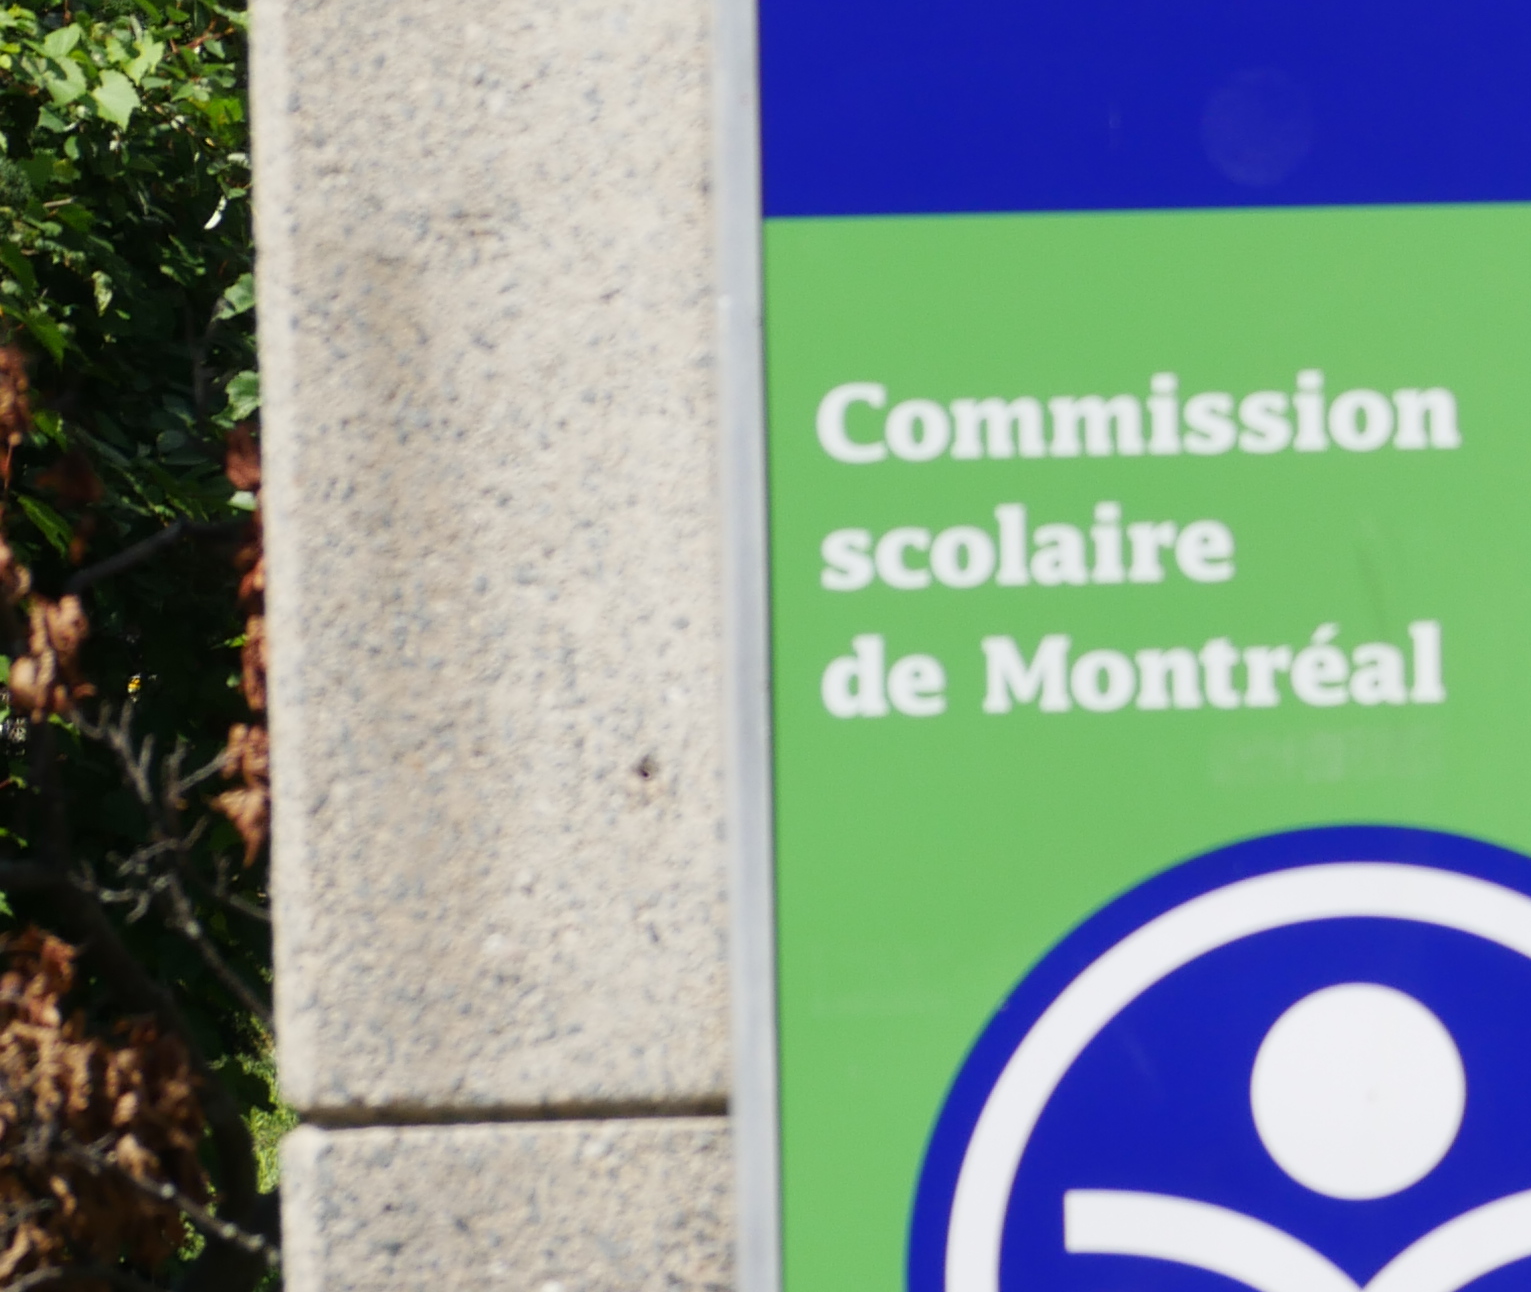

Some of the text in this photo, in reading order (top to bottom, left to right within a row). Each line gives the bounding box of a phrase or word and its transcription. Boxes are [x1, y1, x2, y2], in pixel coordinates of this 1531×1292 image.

[815, 368, 1463, 464] Commission
[819, 501, 1236, 592] scolaire
[820, 619, 1447, 719] de Montréal
